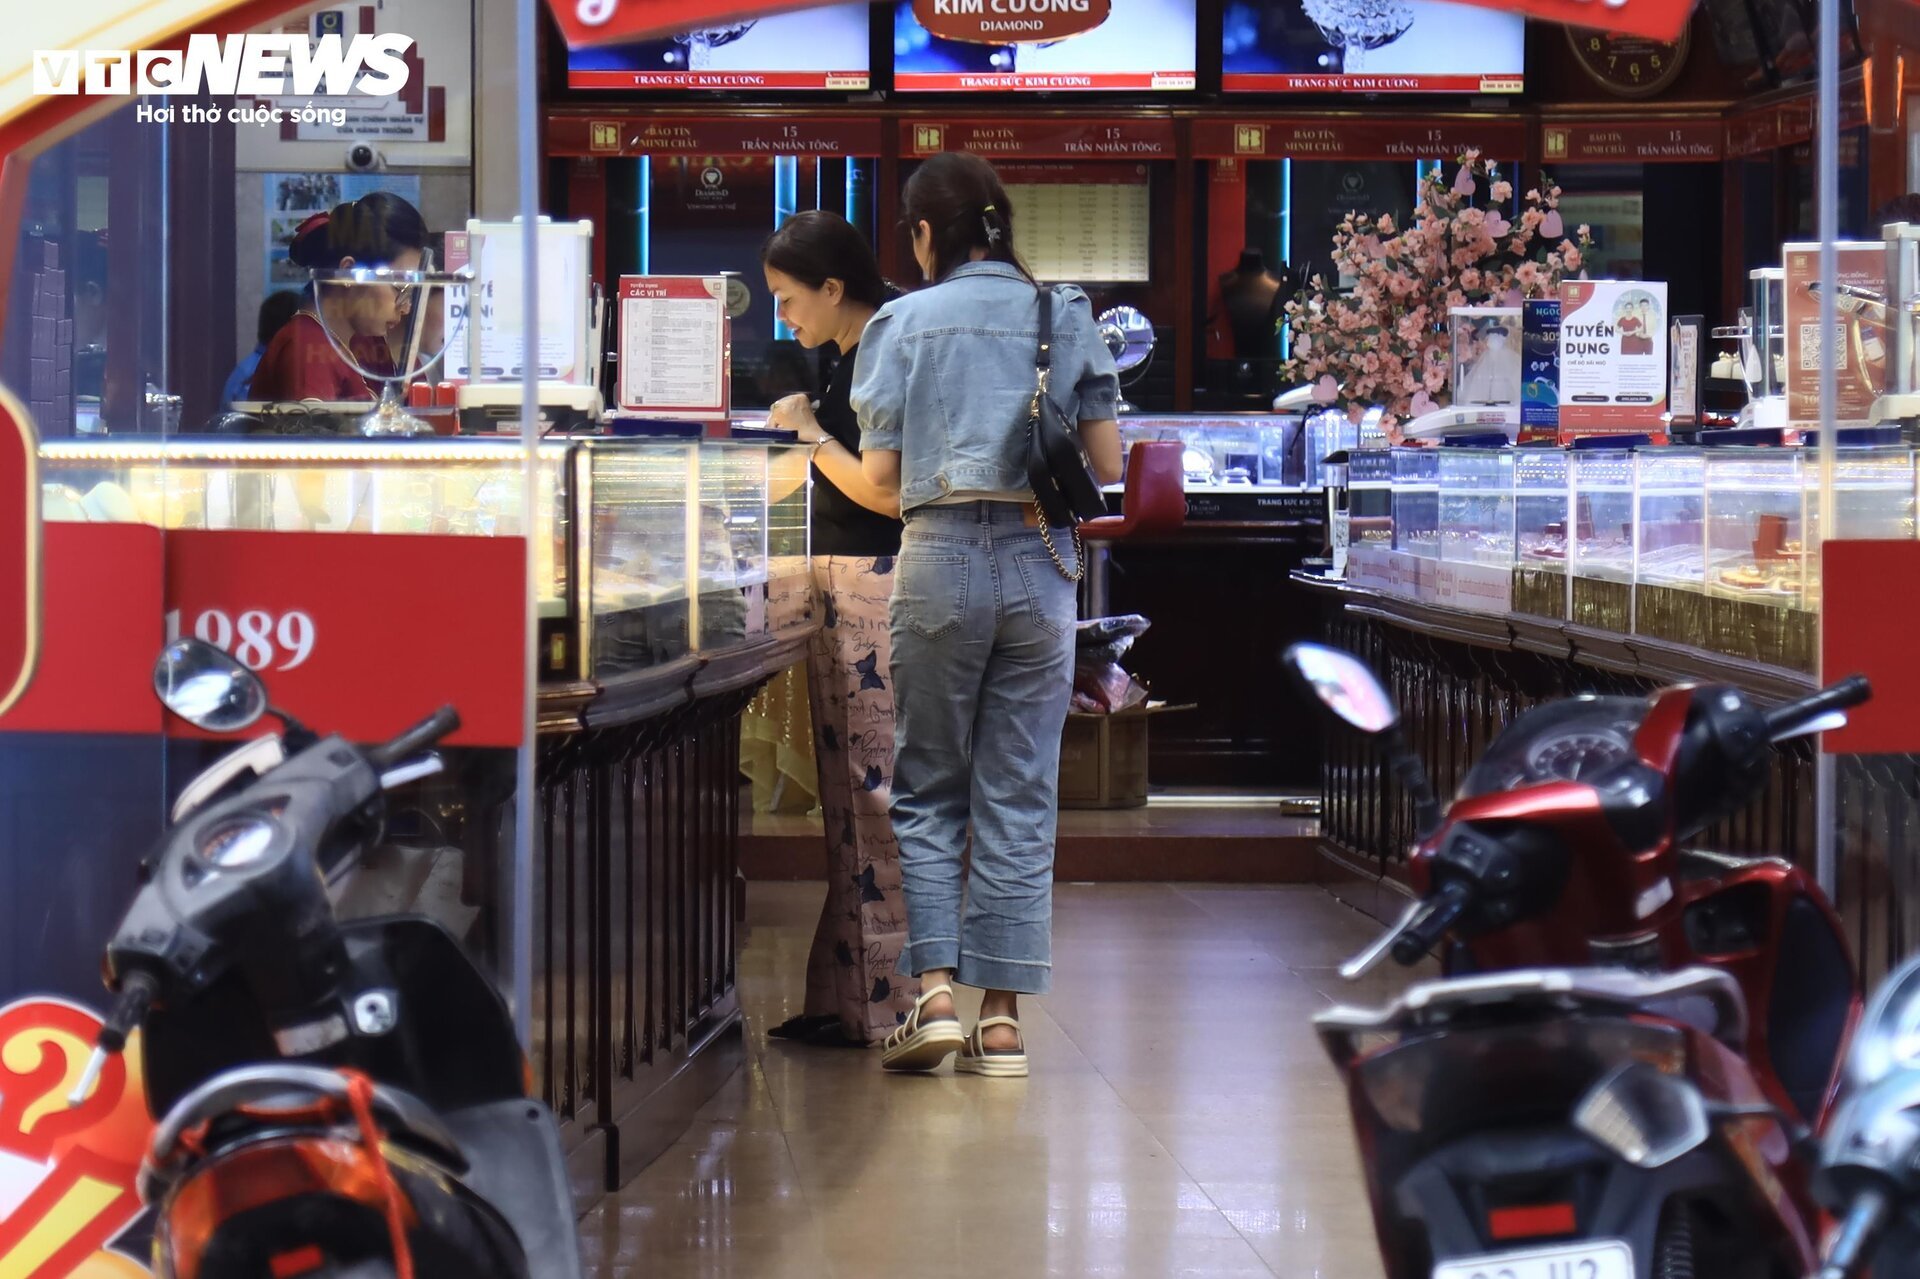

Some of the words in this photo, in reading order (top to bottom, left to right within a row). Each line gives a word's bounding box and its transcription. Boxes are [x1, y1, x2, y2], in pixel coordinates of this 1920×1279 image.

[980, 19, 1044, 31] DIAMOND
[633, 75, 673, 84] TRANG
[674, 73, 696, 84] SỨC
[699, 75, 722, 84] KIM
[723, 74, 765, 84] CƯƠNG
[959, 77, 998, 86] TRANG
[1000, 75, 1024, 86] SỨC
[1025, 77, 1048, 86] KIM
[1049, 76, 1091, 86] CƯƠNG
[1288, 79, 1326, 88] TRANG
[1328, 77, 1351, 88] SỨC
[1353, 79, 1376, 88] KIM
[1377, 77, 1419, 88] CƯƠNG
[782, 126, 798, 138] 15
[1105, 128, 1121, 140] 15
[1427, 130, 1442, 141] 15
[1669, 130, 1682, 142] 15
[640, 137, 669, 148] MINH
[741, 137, 770, 151] TRẦN
[772, 137, 806, 151] NHÂN
[807, 138, 839, 152] TÔNG
[964, 140, 993, 150] MINH
[1065, 140, 1093, 153] TRẦN
[1095, 140, 1129, 153] NHÂN
[1130, 141, 1162, 153] TÔNG
[1385, 140, 1415, 154] TRẦN
[1416, 141, 1451, 155] NHÂN
[1638, 143, 1659, 156] TRẦN
[1660, 143, 1688, 155] NHÂN
[1689, 142, 1714, 155] TÔNG
[630, 288, 645, 296] CÁC
[647, 289, 654, 297] VỊ
[656, 288, 666, 296] TRÍ
[1565, 320, 1615, 338] TUYỂN
[1565, 342, 1611, 358] DỤNG
[1257, 498, 1283, 506] TRANG
